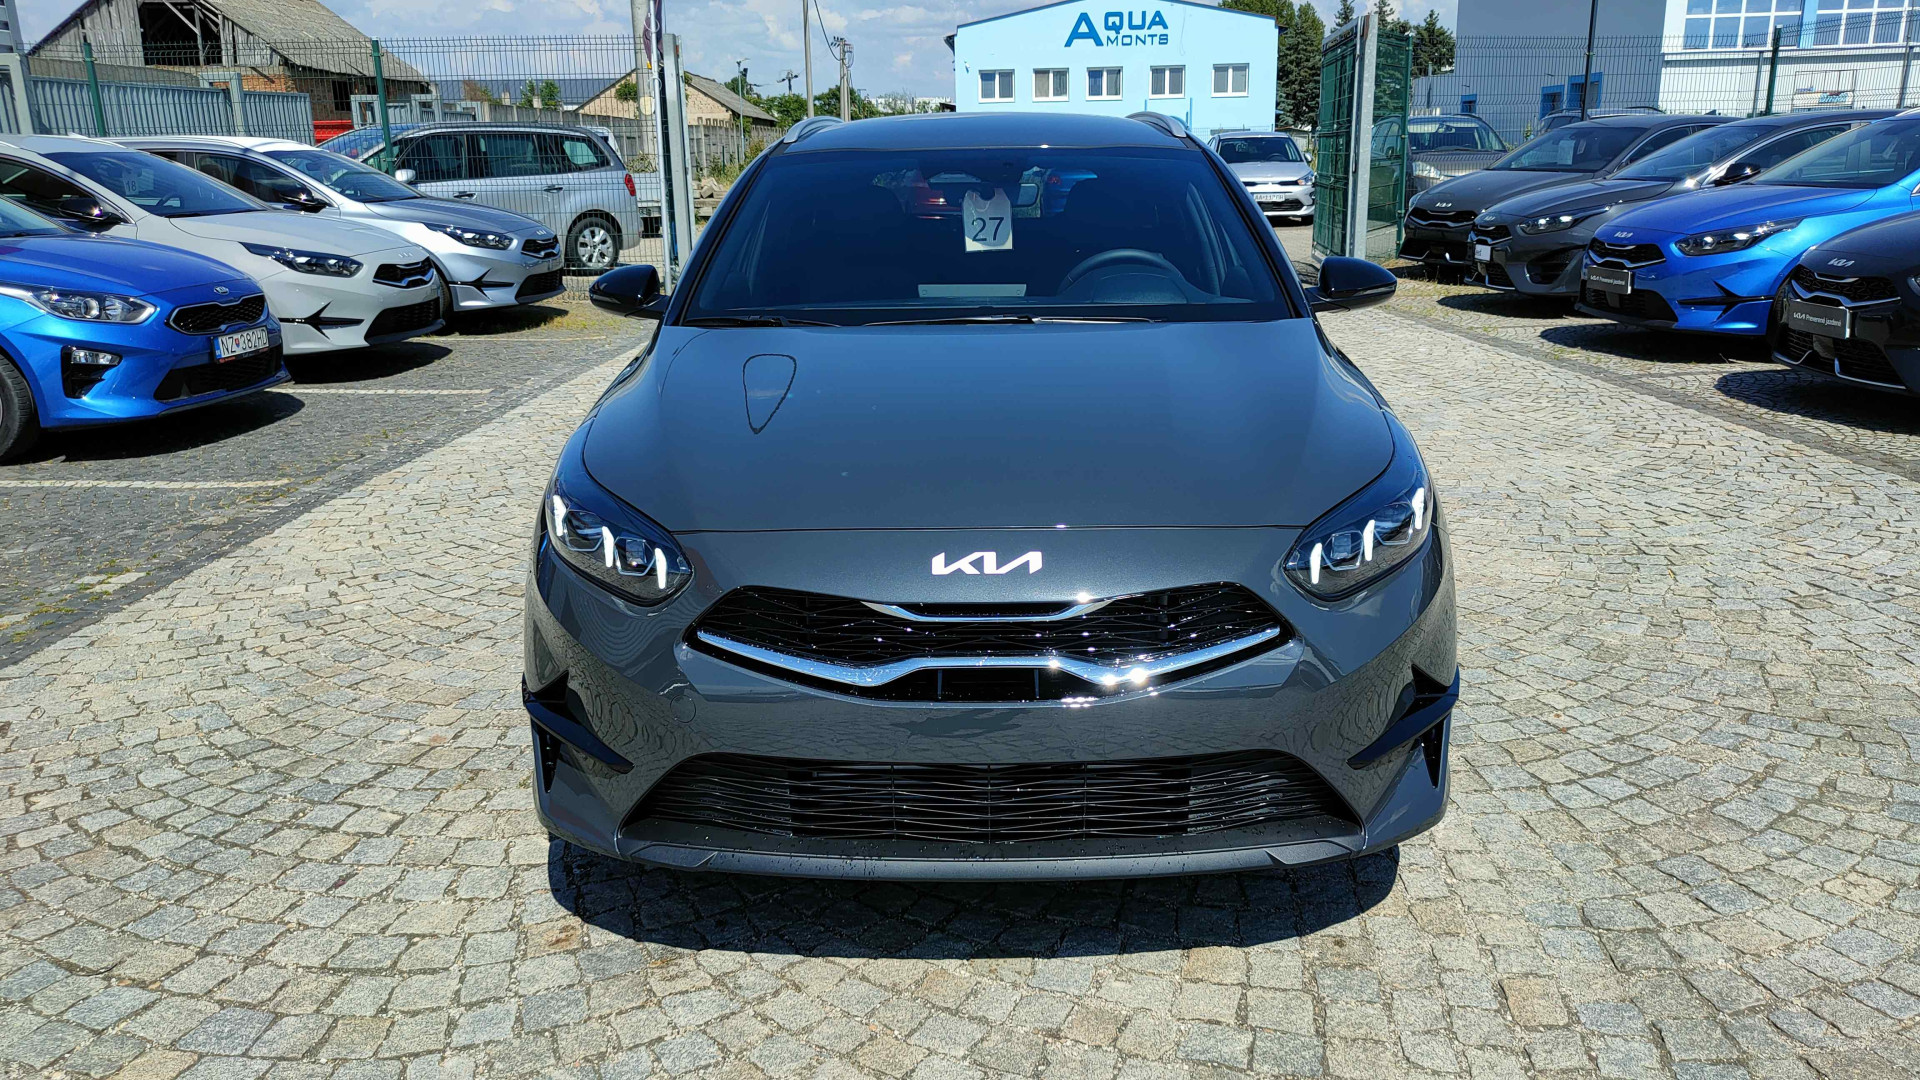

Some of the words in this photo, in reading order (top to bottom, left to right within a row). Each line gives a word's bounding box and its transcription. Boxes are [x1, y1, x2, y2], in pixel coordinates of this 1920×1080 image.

[1064, 10, 1169, 47] AQUA
[1106, 34, 1169, 47] MONTS
[125, 180, 137, 191] 18
[971, 216, 1005, 242] 27
[1827, 258, 1855, 267] KIA
[220, 336, 236, 356] NZ
[240, 328, 269, 351] 382HD
[931, 551, 1042, 575] KIA
